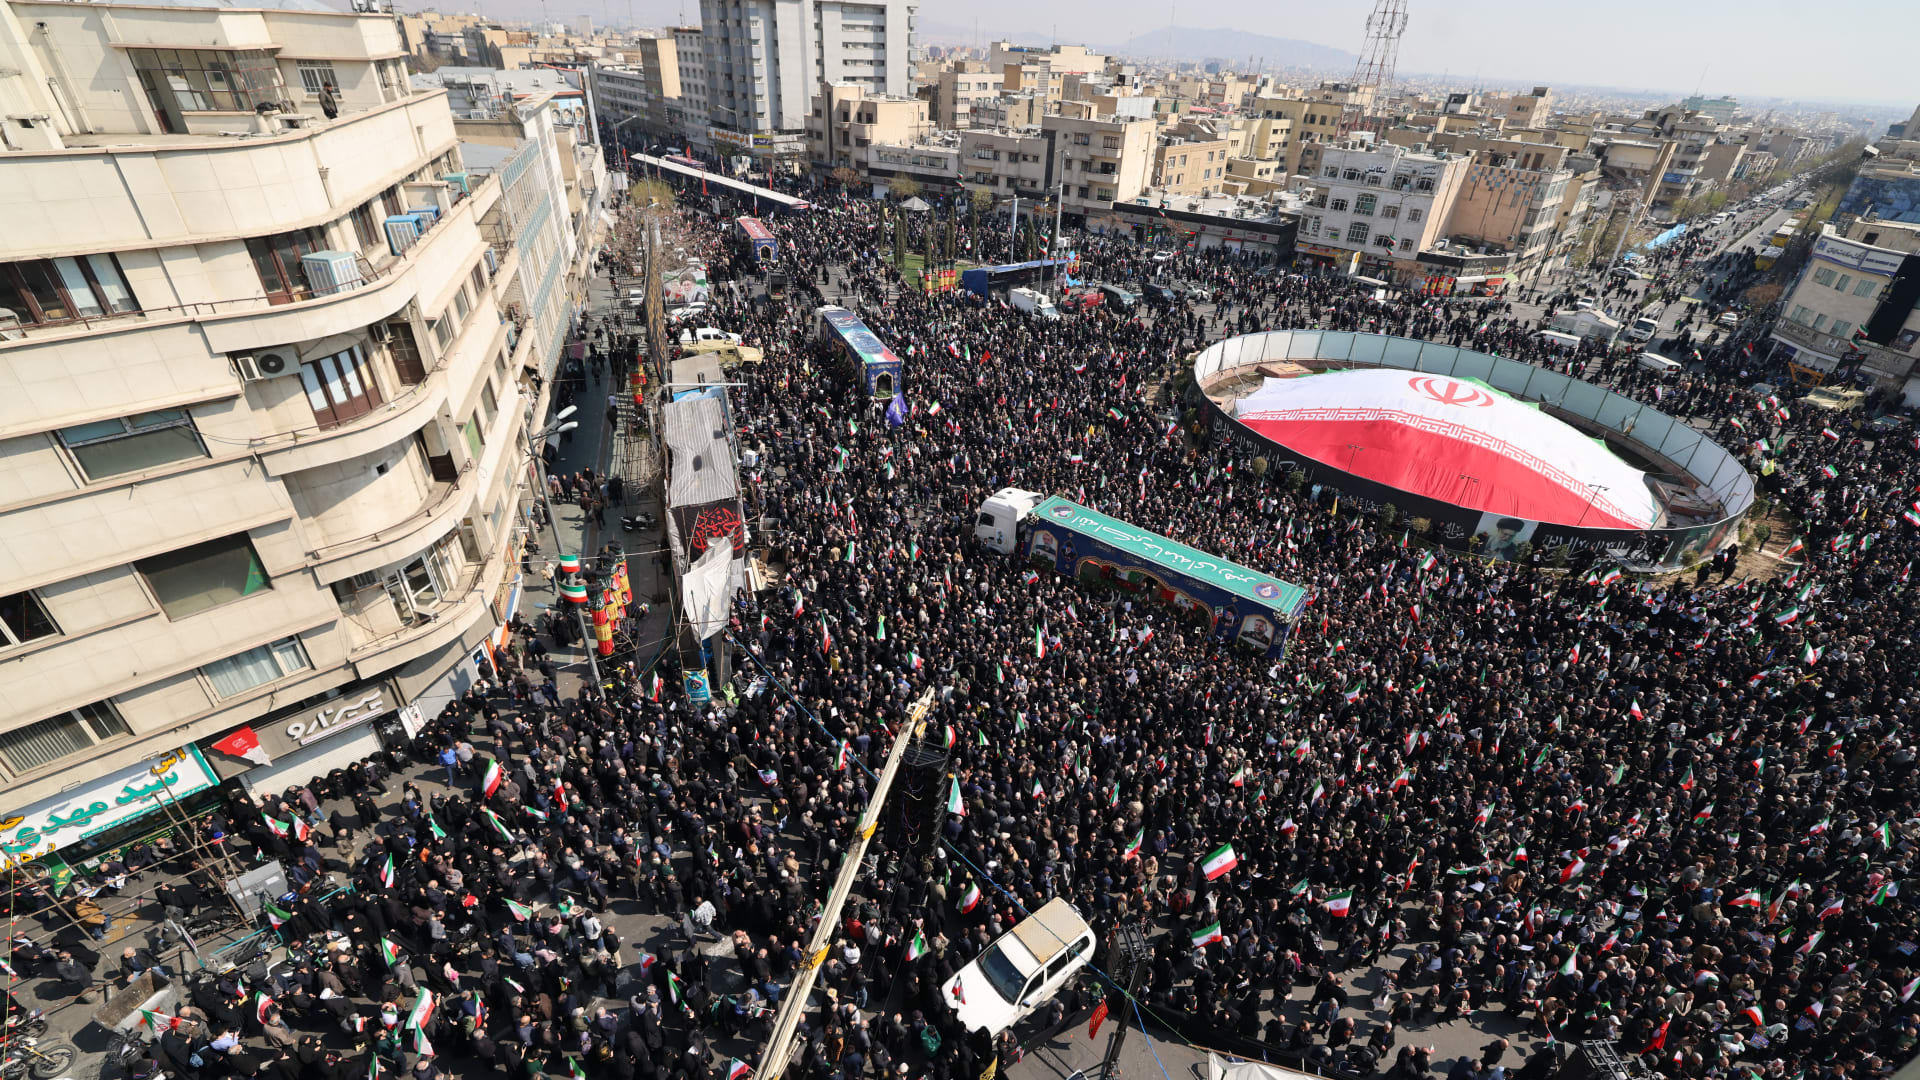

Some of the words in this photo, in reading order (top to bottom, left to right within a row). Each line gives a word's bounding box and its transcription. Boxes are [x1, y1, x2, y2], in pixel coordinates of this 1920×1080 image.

[1095, 522, 1153, 543] اکبر
[1218, 568, 1257, 584] رهبر
[115, 770, 179, 804] سید
[1, 801, 109, 854] مهدی
